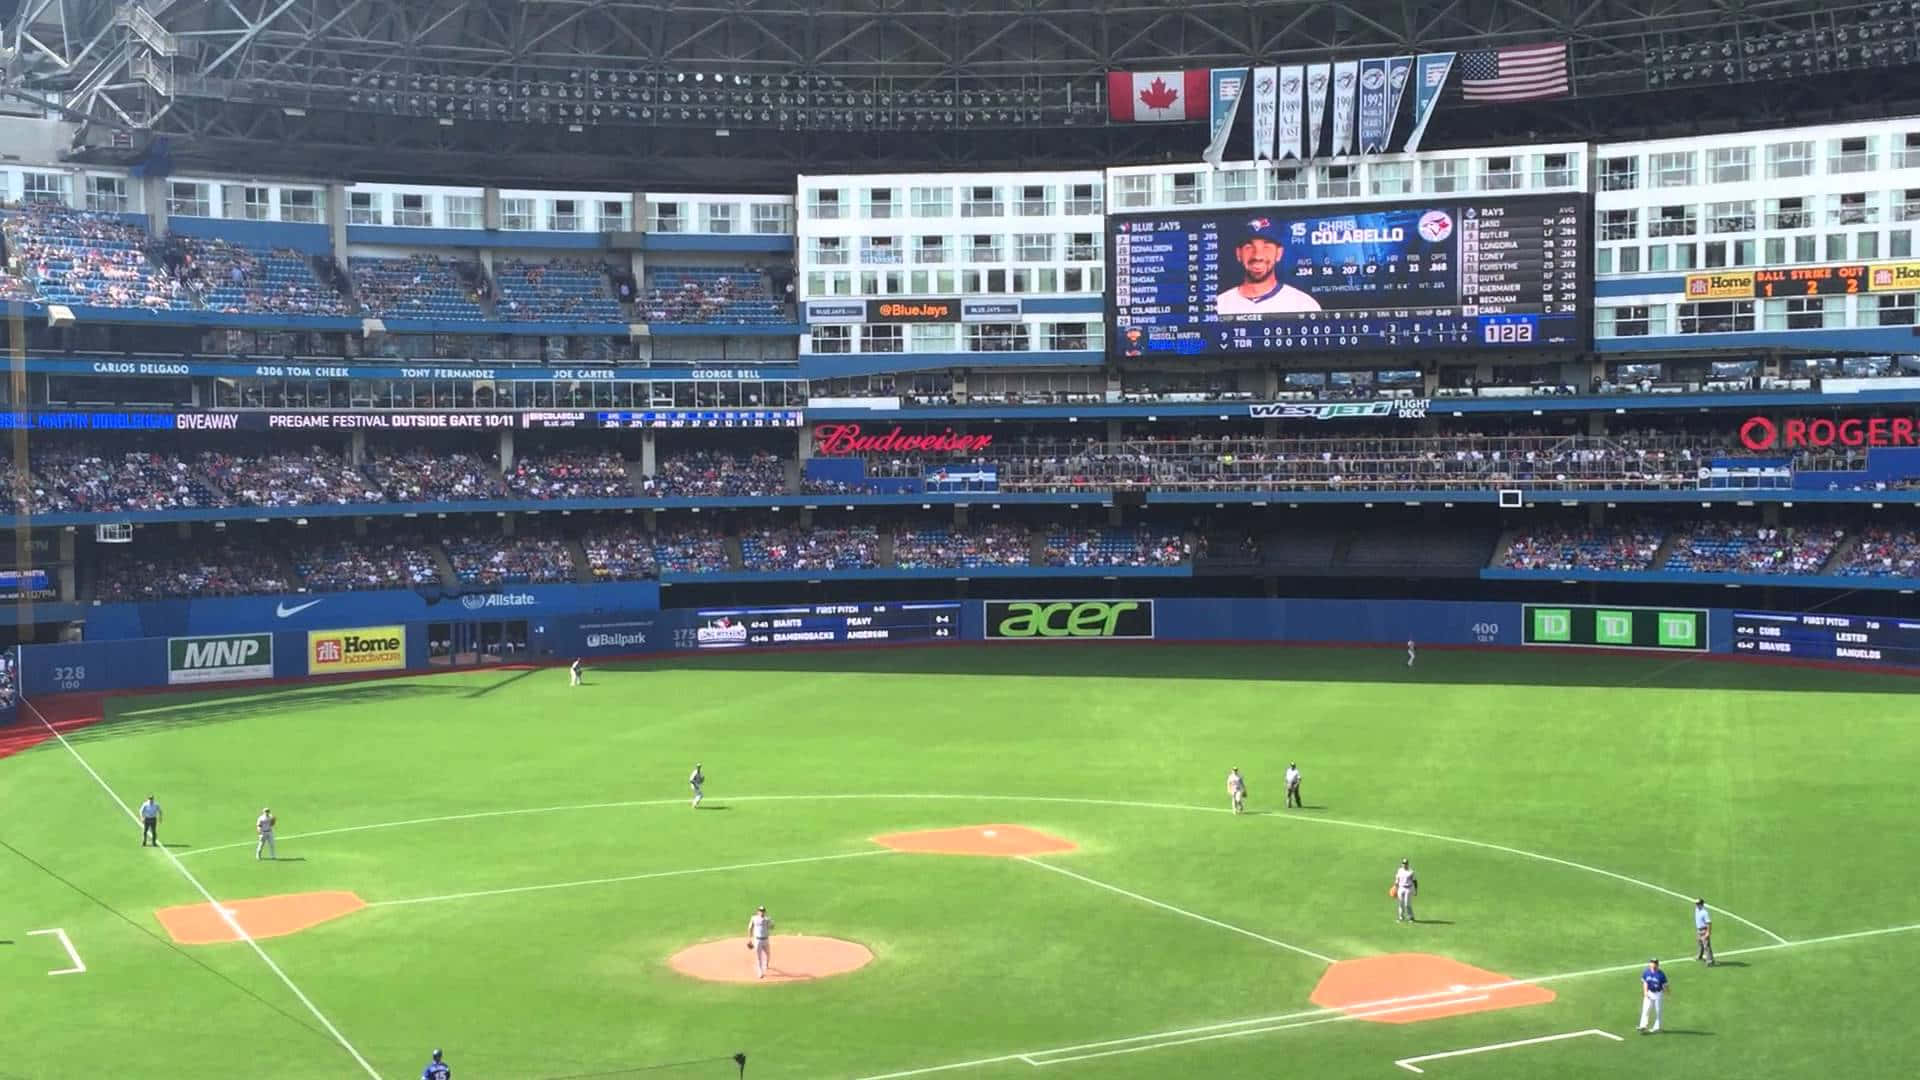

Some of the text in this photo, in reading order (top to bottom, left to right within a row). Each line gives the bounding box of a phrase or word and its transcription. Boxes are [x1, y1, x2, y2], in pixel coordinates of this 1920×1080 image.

[1363, 93, 1382, 107] 1992
[1481, 207, 1504, 217] RAYS
[1132, 222, 1154, 232] BLUE
[1158, 222, 1180, 231] JAYS
[1290, 222, 1306, 237] 15
[1318, 220, 1354, 232] CHRIS
[1311, 228, 1404, 246] COLABELLO
[1480, 231, 1509, 239] BUTLER
[1480, 252, 1504, 260] LONEY
[1342, 265, 1357, 274] 207
[1480, 262, 1519, 271] FORSYTHE
[1131, 276, 1155, 284] SMOAK
[1757, 267, 1863, 281] BALL STRIKE OUT
[1710, 277, 1751, 289] Home
[1765, 283, 1773, 297] 1
[1808, 281, 1818, 294] 2
[1847, 279, 1858, 293] 2
[1131, 296, 1156, 304] PILLAR
[1480, 295, 1517, 304] BECKHAM
[880, 304, 948, 318] @BlueJays
[1131, 306, 1171, 314] COLABELLO
[1480, 306, 1506, 314] CASALI
[1545, 305, 1551, 313] C
[1233, 328, 1246, 336] TB
[1489, 326, 1529, 340] 1 2 2
[1233, 339, 1252, 348] TOR
[1460, 334, 1467, 342] 6
[94, 362, 189, 375] CARLOS DELGADO
[256, 367, 349, 377] 4306 TOM CHEEK
[402, 369, 495, 379] TONY FERNANDEZ
[553, 369, 615, 379] JOE CARTER
[692, 370, 760, 379] GEORGE BELL
[1249, 399, 1431, 419] WESTJET FLIGHT
[1398, 409, 1425, 418] DECK
[177, 414, 239, 429] GIVEAWAY
[270, 414, 514, 427] PREGAME FESTIVAL OUTSIDE GATE 10/11
[1785, 417, 1920, 447] ROGER
[816, 422, 993, 456] Budweiser
[485, 593, 535, 607] Allstate
[816, 605, 859, 614] FIRST PITCH
[773, 617, 872, 628] GIANTS PEAVY
[1000, 602, 1138, 637] acer
[1803, 616, 1850, 627] FIRST PITCH
[1472, 623, 1498, 635] 400
[1538, 615, 1693, 639] TD TD TD
[600, 632, 646, 647] Ballpark
[674, 629, 696, 639] 375
[774, 631, 835, 642] DIAMONDBACKS
[847, 629, 889, 639] ANDERSON
[1759, 626, 1868, 643] CUBS LESTER
[344, 636, 400, 654] Home
[1759, 642, 1881, 659] BRAVES BANUELOS
[183, 639, 259, 669] MNP
[54, 666, 85, 681] 328
